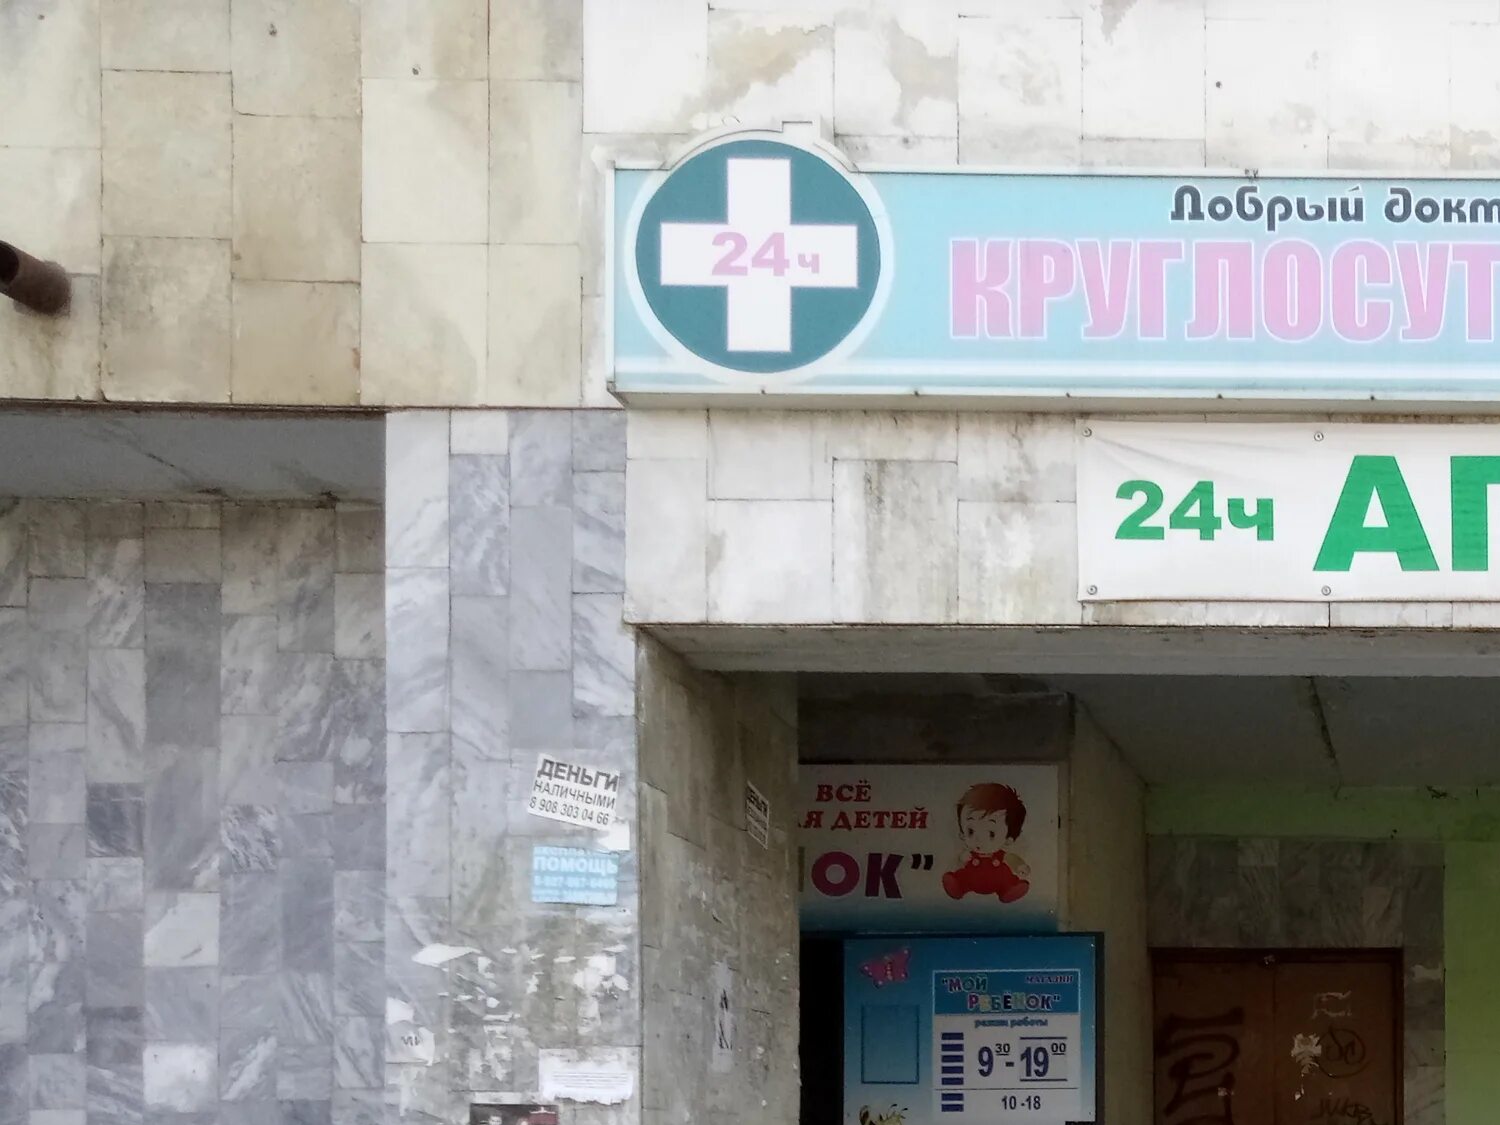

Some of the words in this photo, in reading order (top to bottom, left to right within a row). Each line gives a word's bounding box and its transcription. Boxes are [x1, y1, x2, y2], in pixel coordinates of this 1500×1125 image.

[1170, 184, 1364, 232] Добрый
[1114, 479, 1275, 541] 24ч
[537, 758, 619, 792] ДЕНЬГИ
[533, 780, 616, 809] НАЛИЧНЫМИ
[815, 779, 872, 803] ВСЁ
[539, 798, 557, 814] 908
[560, 803, 579, 819] 303
[581, 809, 594, 822] 04
[597, 812, 609, 826] 66
[830, 806, 930, 831] ДЕТЕЙ
[533, 855, 619, 876] ПОМОЩЬ
